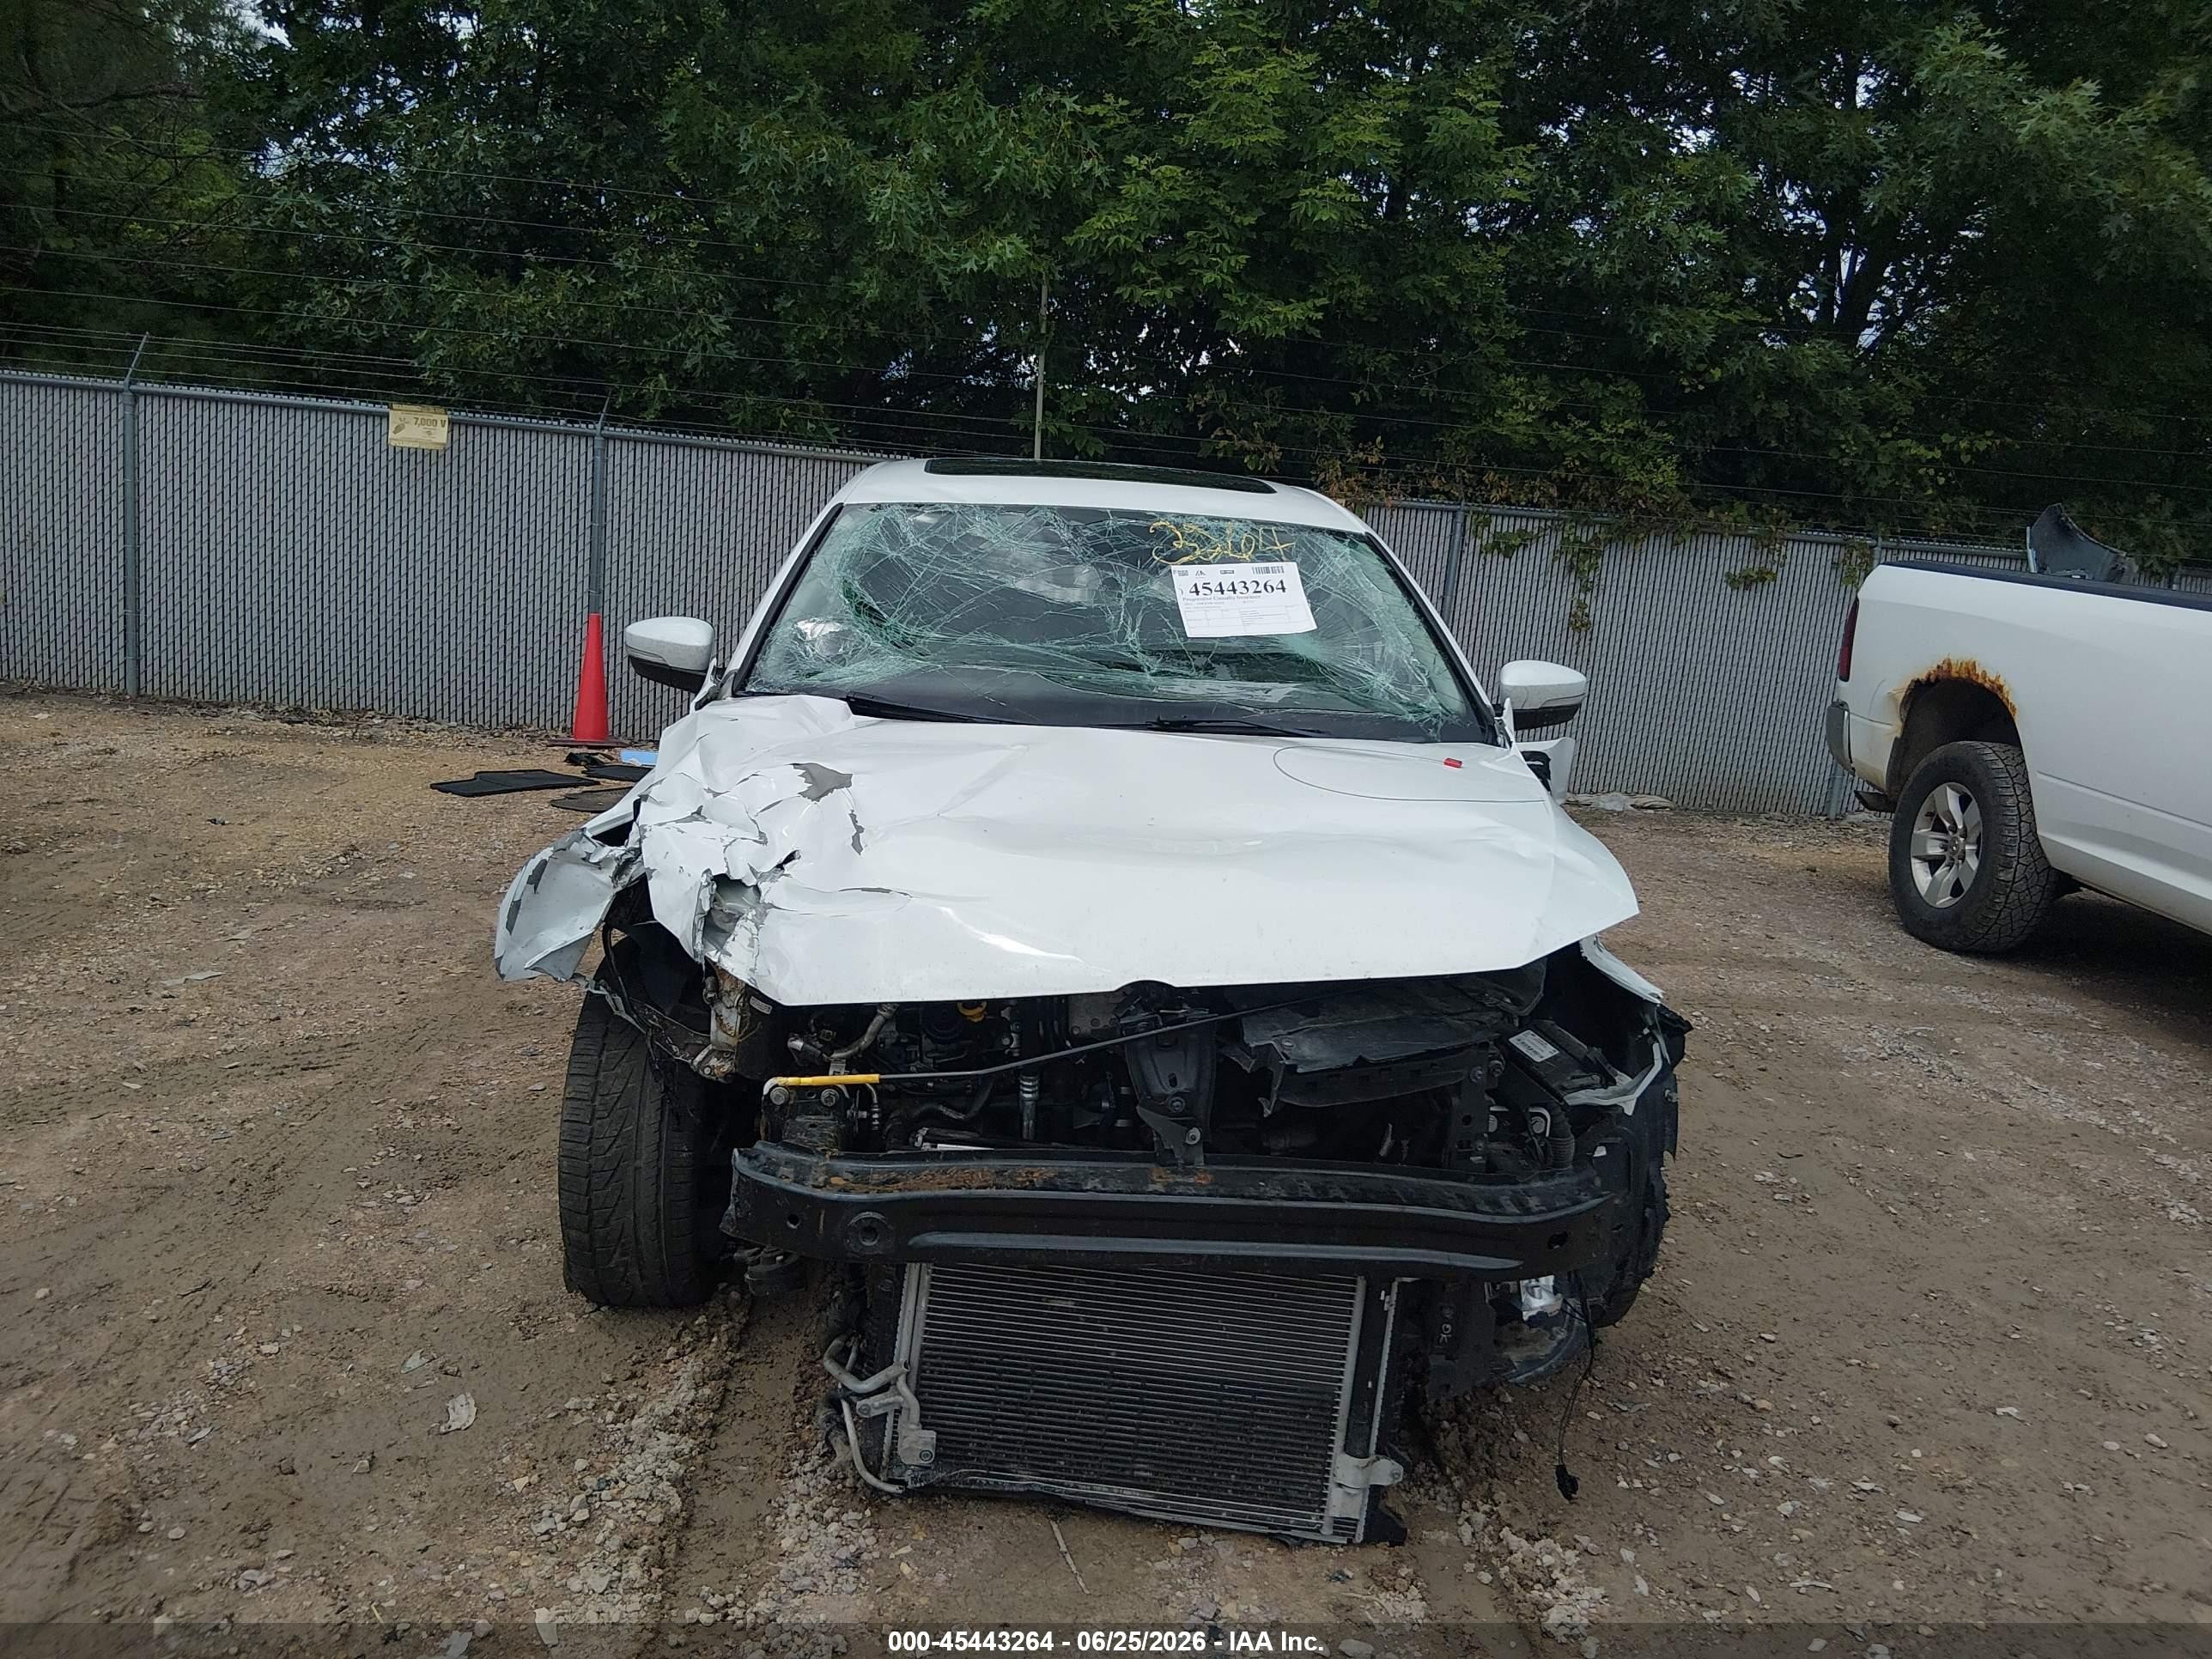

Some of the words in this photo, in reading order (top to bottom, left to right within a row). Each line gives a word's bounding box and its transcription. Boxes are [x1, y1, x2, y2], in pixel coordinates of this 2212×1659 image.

[413, 416, 438, 428] 7,000
[440, 419, 447, 428] V
[1188, 579, 1286, 596] 45443264
